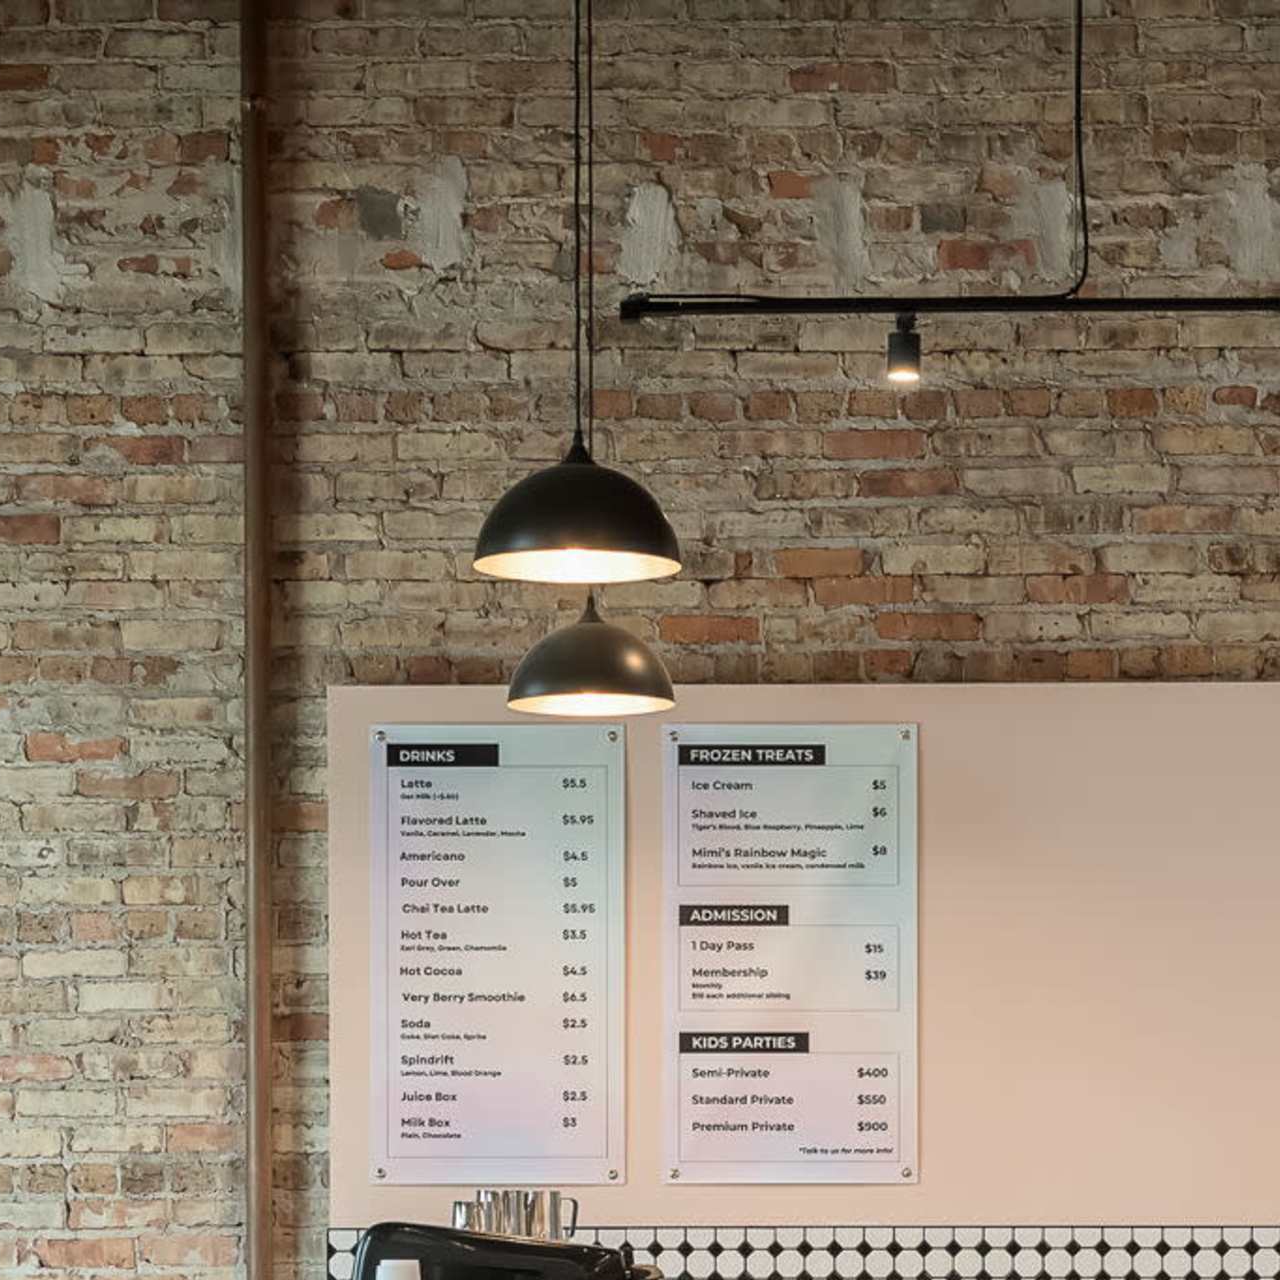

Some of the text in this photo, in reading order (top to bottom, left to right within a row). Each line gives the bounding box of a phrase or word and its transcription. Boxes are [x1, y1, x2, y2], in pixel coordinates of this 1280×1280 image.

[399, 750, 455, 763] DRINKS
[690, 750, 814, 762] FROZEN TREATS
[401, 778, 586, 789] Latte $5.5
[692, 780, 886, 791] Ice Cream $5
[692, 807, 887, 819] Shaved Ice $6
[401, 815, 594, 826] Flavored Latte $5.95
[400, 851, 588, 862] Americano $4.5
[692, 846, 887, 860] Mimi's Rainbow Magic $8
[401, 877, 577, 888] Pour Over $5
[402, 903, 595, 914] Chai Tea Latte $5.95
[690, 909, 777, 921] ADMISSION
[401, 930, 586, 940] Hot Tea $3.5
[692, 941, 884, 954] 1 Day Pass $15
[400, 966, 587, 976] Hot Cocoa $4.5
[692, 968, 886, 981] Membership $39
[402, 992, 587, 1004] Very Berry Smoothie $6.5
[401, 1018, 588, 1029] Soda $2.5
[692, 1037, 796, 1049] KIDS PARTIES
[401, 1055, 588, 1067] Spindrift $2.5
[692, 1067, 888, 1079] Semi-Private $400
[401, 1091, 587, 1102] Juice Box $2.5
[692, 1095, 886, 1105] Standard Private $550
[401, 1117, 577, 1128] Milk Box $3
[692, 1121, 888, 1132] Premium Private $900
